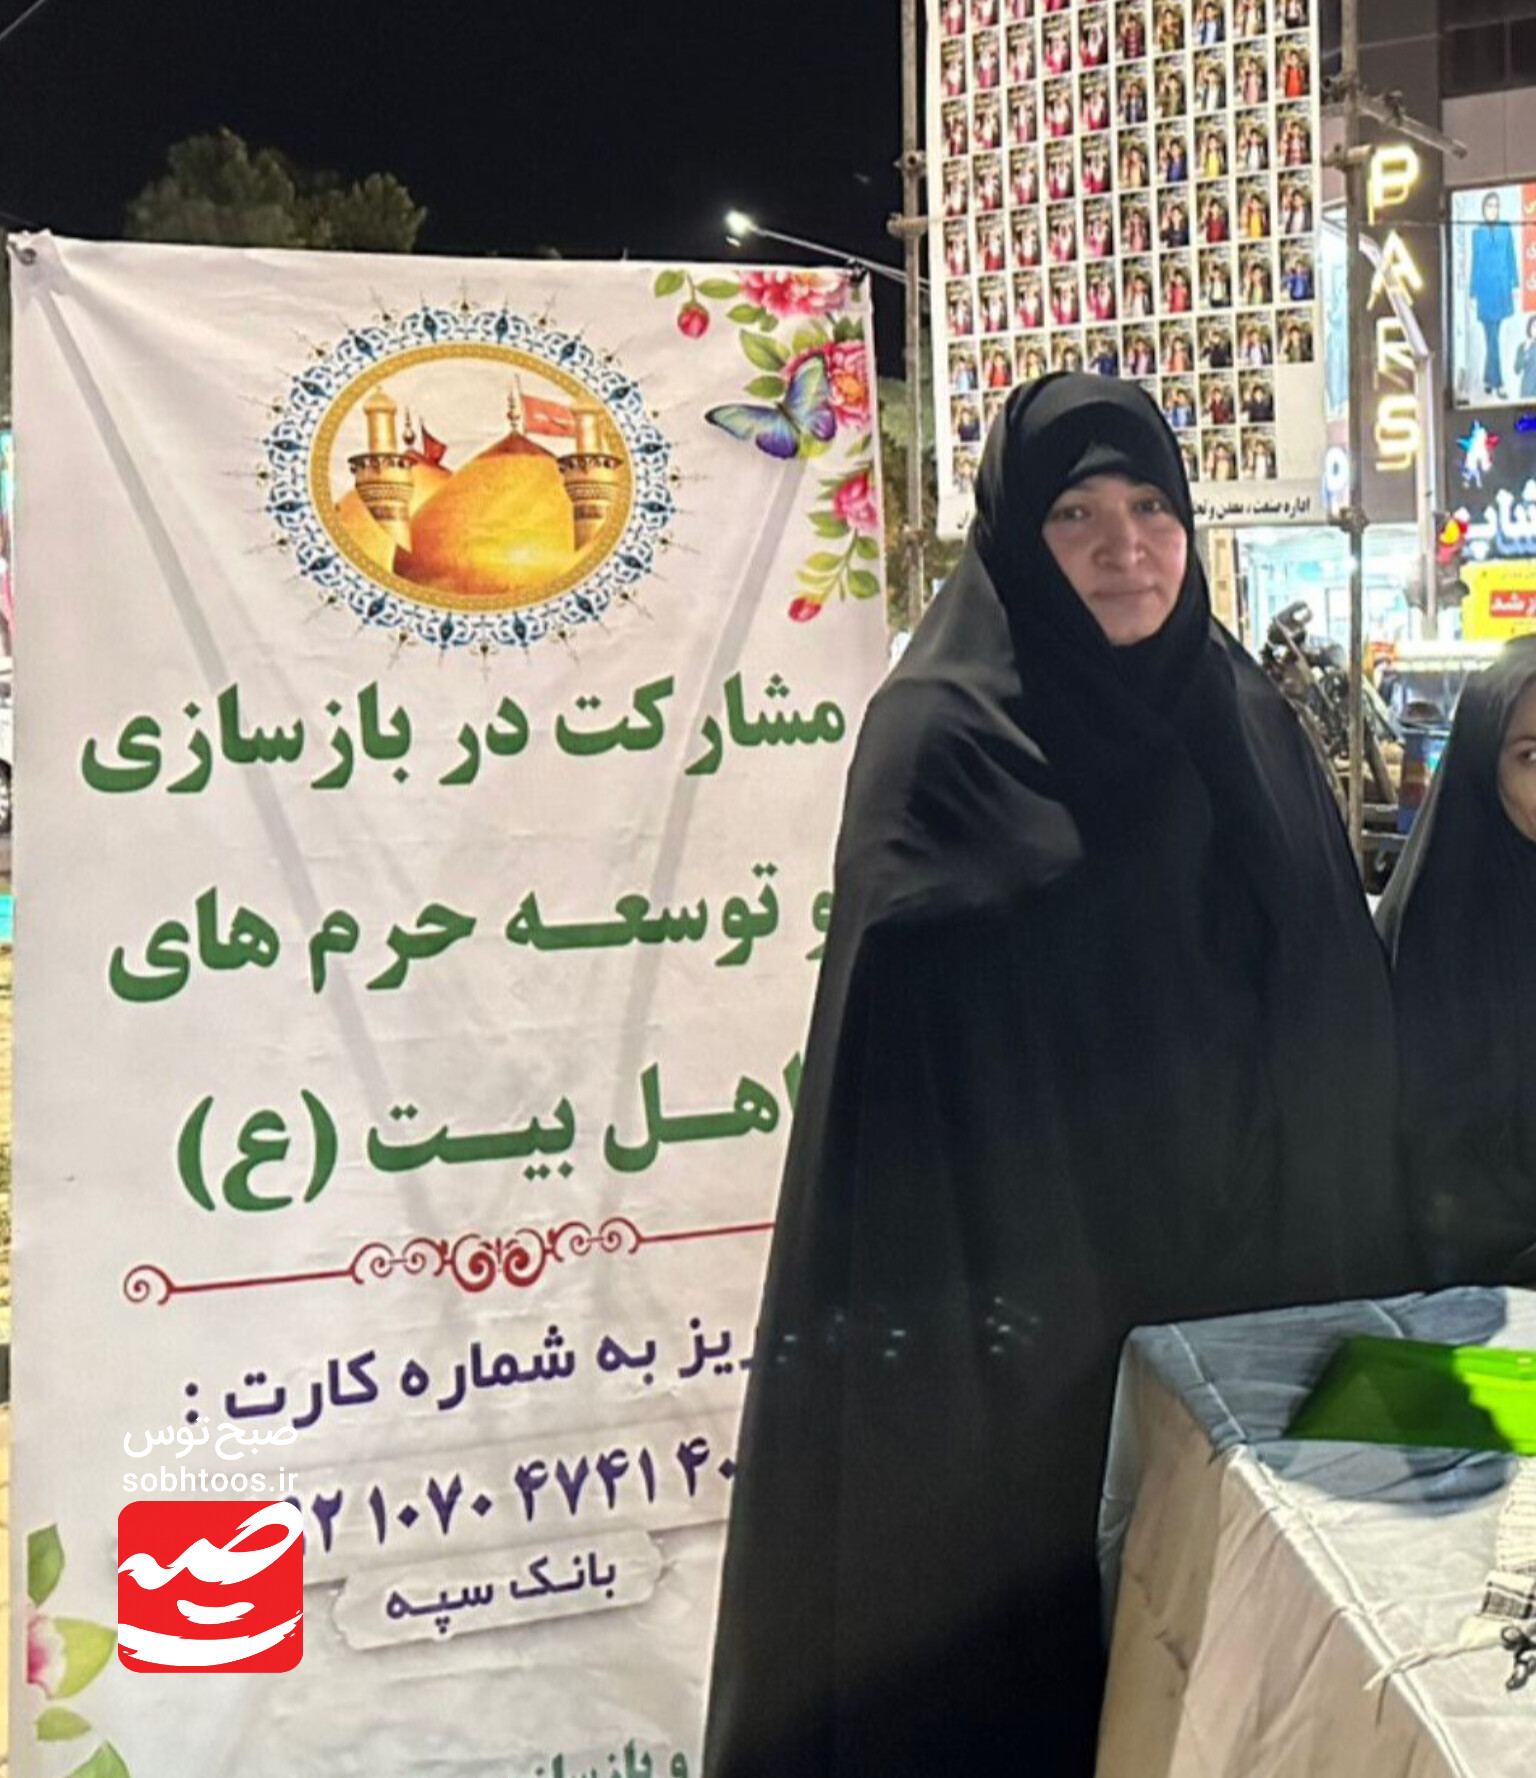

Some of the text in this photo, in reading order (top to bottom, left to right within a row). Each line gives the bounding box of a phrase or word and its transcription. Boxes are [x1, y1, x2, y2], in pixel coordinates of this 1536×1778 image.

[1366, 145, 1425, 470] PARS
[1252, 498, 1283, 514] صنعت
[1490, 592, 1526, 613] شد
[80, 670, 847, 794] مشارکت در بازسازی
[107, 887, 281, 1003] های
[308, 901, 478, 994] حرم
[504, 863, 780, 968] توسعه
[176, 1090, 339, 1212] (ع)
[366, 1096, 577, 1182] بیت
[224, 1350, 379, 1430] کارت
[399, 1325, 576, 1410] شماره
[596, 1335, 657, 1386] به
[368, 1474, 494, 1546] ۱۰۷۰
[513, 1447, 657, 1522] ۴۷۴۱
[385, 1552, 617, 1635] بانک سپه
